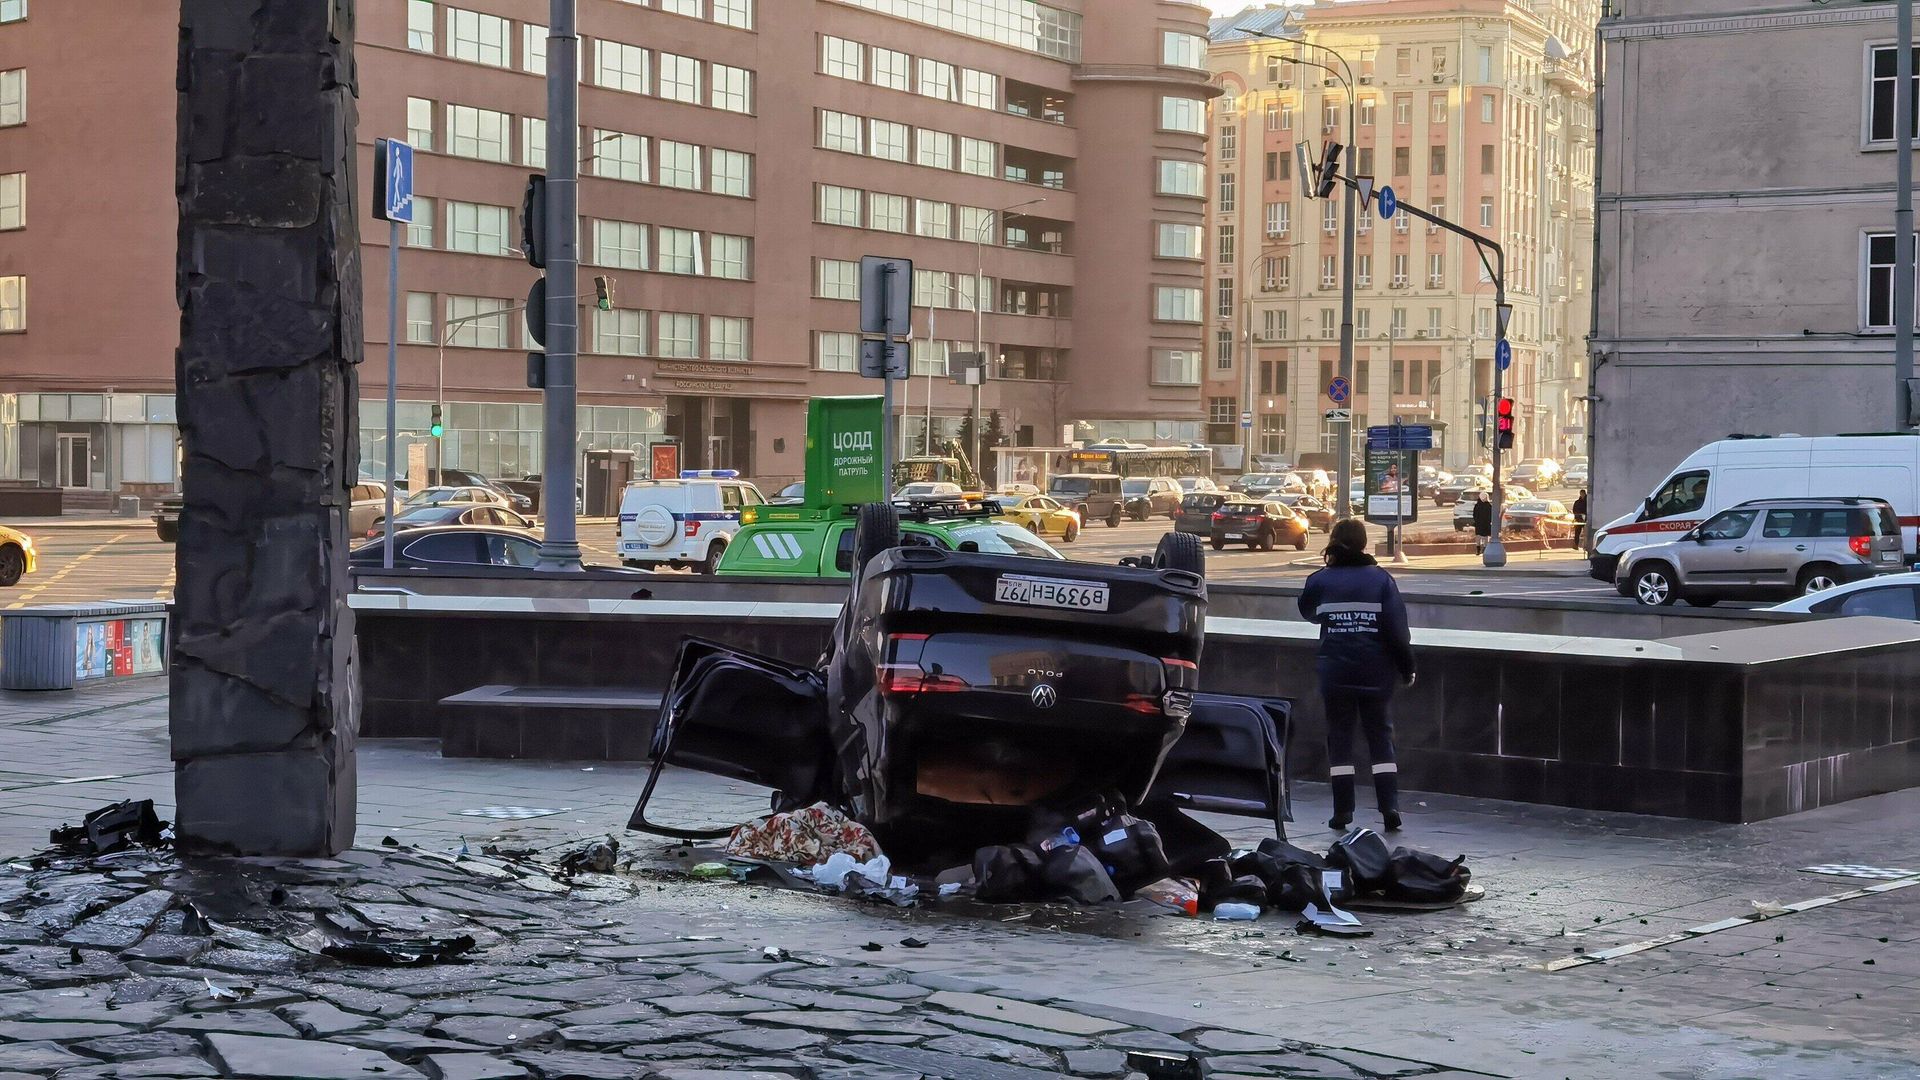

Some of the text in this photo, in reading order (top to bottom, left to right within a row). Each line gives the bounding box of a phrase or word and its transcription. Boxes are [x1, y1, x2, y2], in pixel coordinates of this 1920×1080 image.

[833, 431, 873, 452] ЦОДД
[833, 454, 873, 467] ДОРОЖНЫЙ
[838, 467, 869, 476] ПАТРУЛЬ
[1659, 522, 1691, 530] СКОРАЯ
[1000, 587, 1028, 602] 797
[1328, 612, 1377, 621] ЭКЦ УВД
[1027, 668, 1063, 678] POLO
